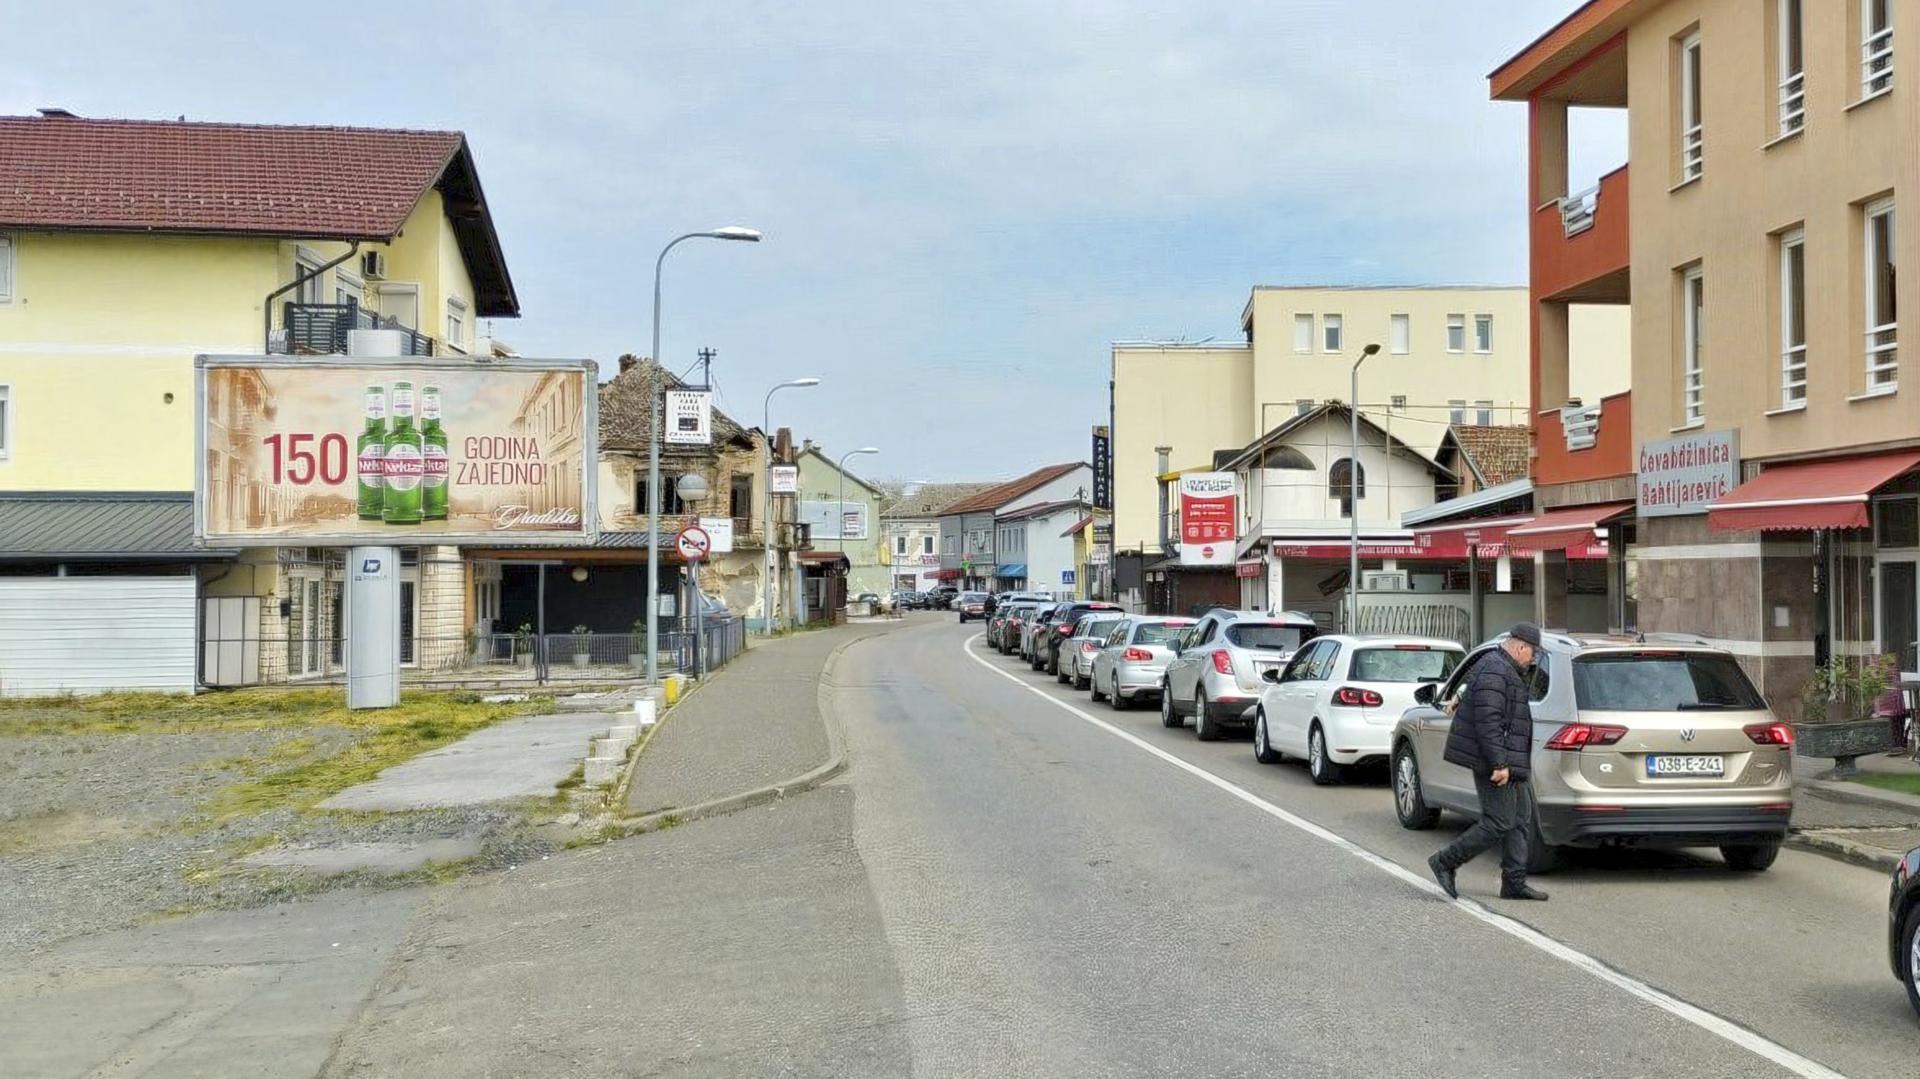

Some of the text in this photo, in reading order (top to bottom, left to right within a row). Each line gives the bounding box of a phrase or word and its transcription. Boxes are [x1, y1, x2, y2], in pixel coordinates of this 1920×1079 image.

[263, 432, 348, 487] 150
[465, 436, 540, 460] GODINA
[456, 462, 548, 486] ZAJEDNO!
